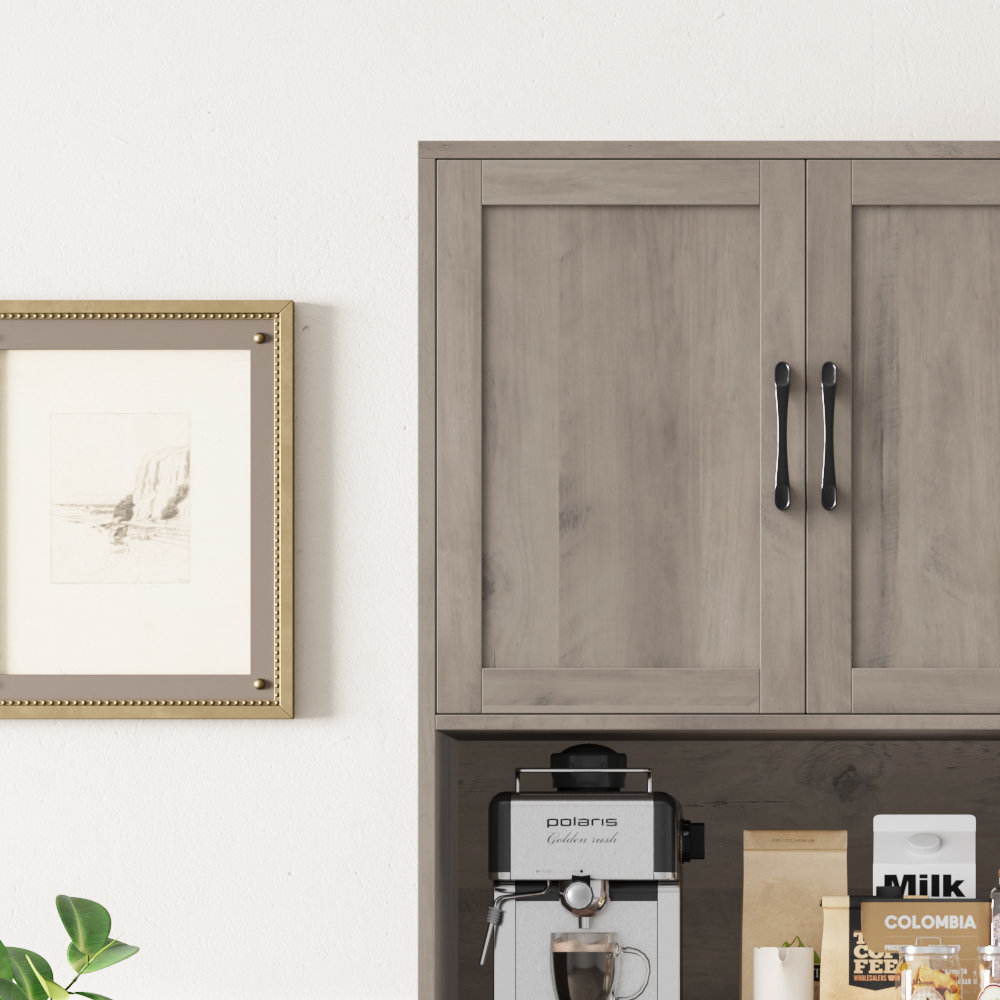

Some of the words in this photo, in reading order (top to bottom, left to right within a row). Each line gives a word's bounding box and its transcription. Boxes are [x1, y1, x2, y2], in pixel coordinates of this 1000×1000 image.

[547, 816, 618, 828] polaris
[884, 874, 966, 898] Milk
[884, 915, 977, 930] COLOMBIA
